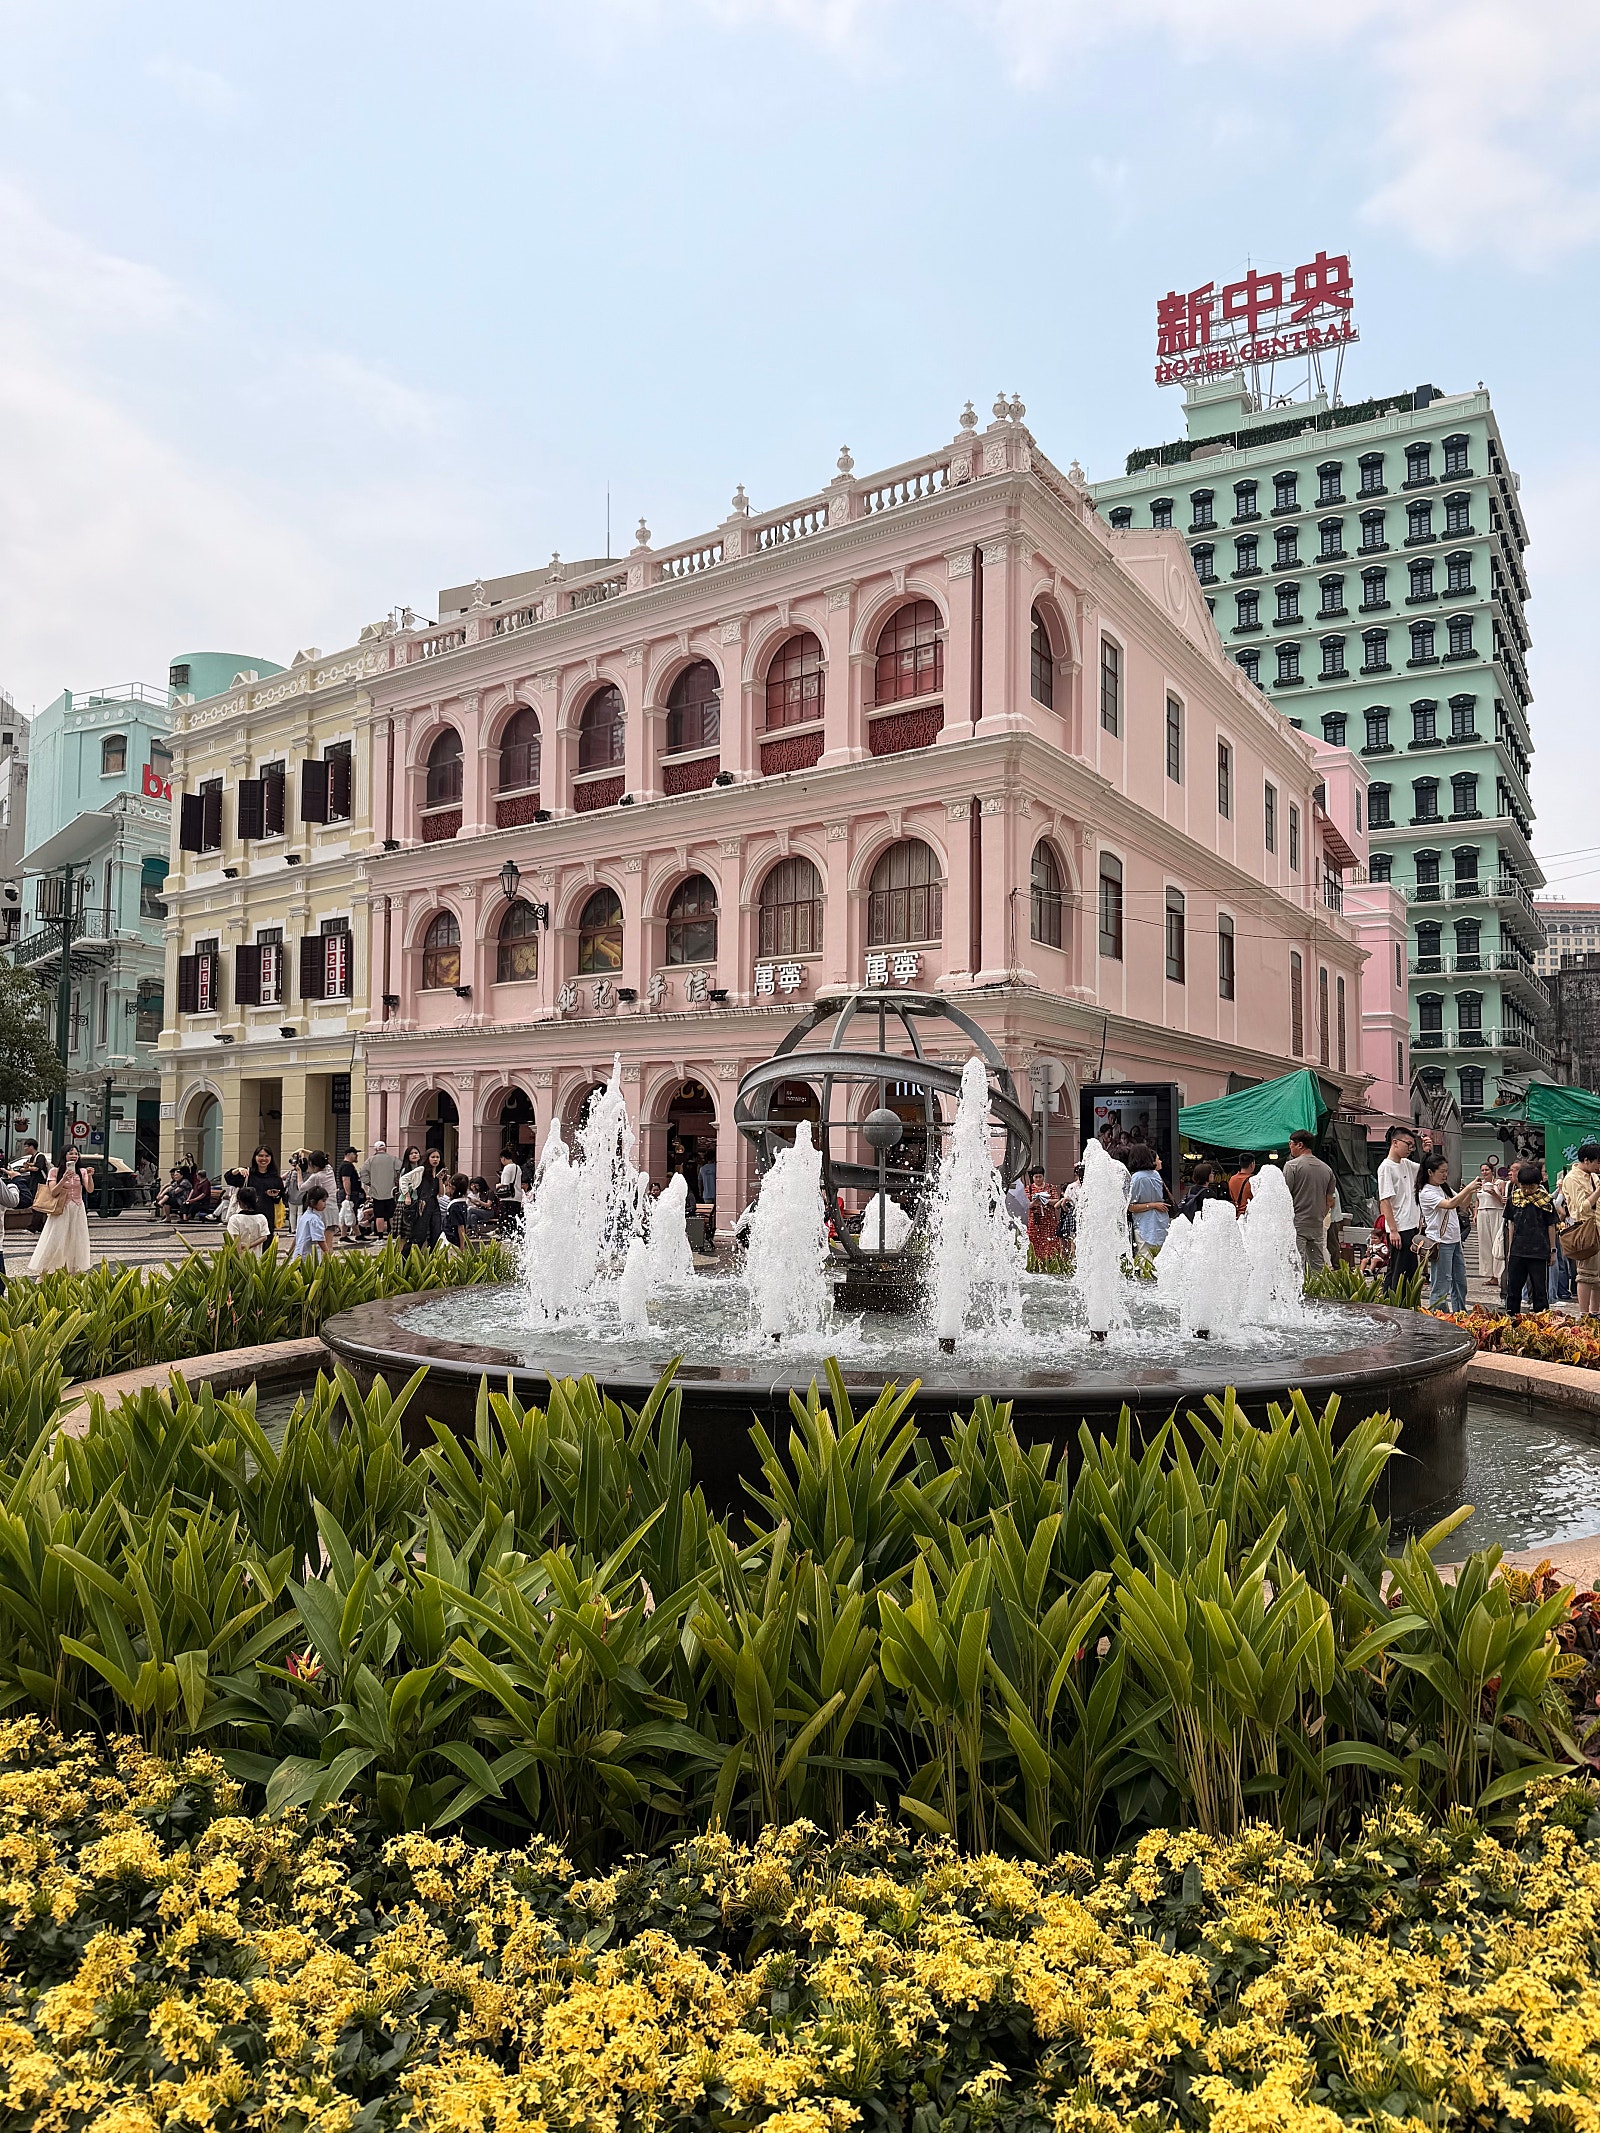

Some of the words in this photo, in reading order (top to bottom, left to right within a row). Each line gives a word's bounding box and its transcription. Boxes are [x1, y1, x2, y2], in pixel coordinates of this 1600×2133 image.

[1157, 250, 1354, 356] 新中央
[1155, 349, 1235, 382] HOTEL
[1240, 320, 1358, 362] CENTRAL
[753, 961, 802, 997] 萬寧
[864, 949, 919, 988] 萬寧
